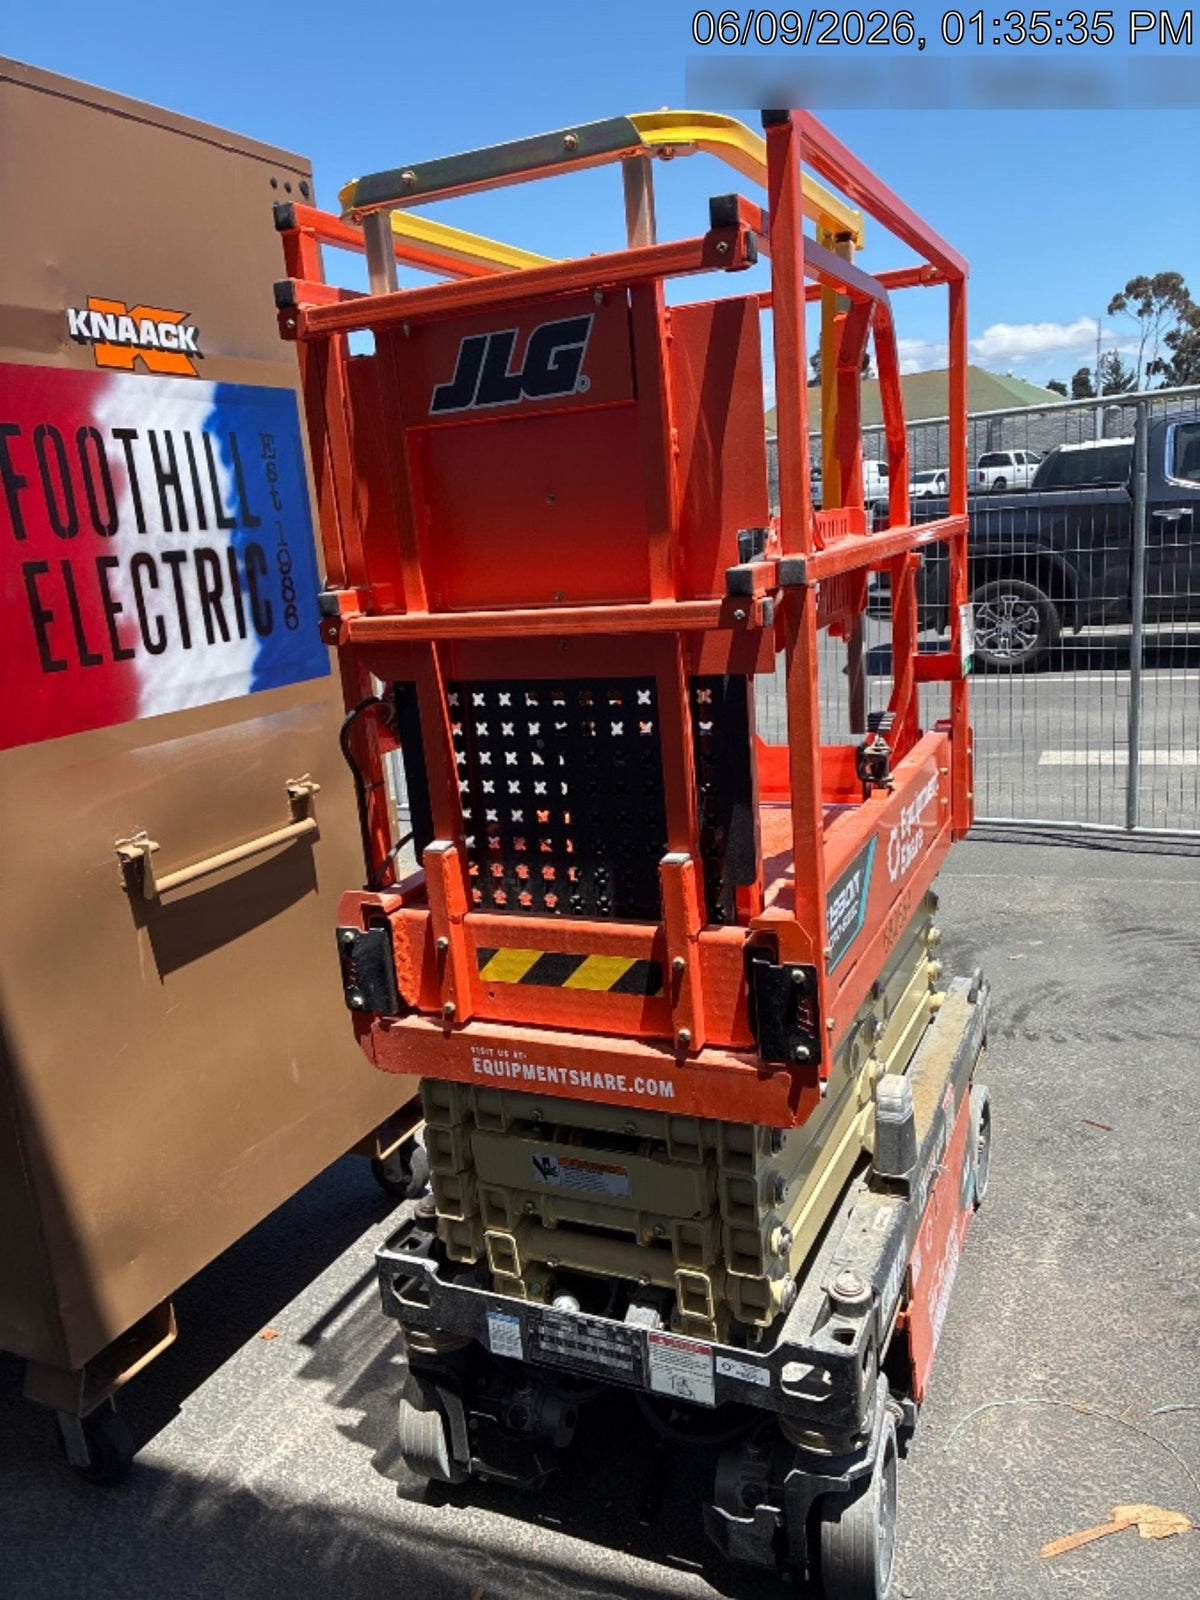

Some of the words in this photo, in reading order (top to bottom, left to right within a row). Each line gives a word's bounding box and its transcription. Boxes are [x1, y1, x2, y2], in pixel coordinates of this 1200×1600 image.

[67, 308, 201, 354] KNAACK
[0, 423, 261, 541] FOOTHILL
[23, 542, 273, 673] ELECTRIC
[274, 520, 299, 631] 1986
[472, 1057, 676, 1099] EQUIPMENTSHARE.COM
